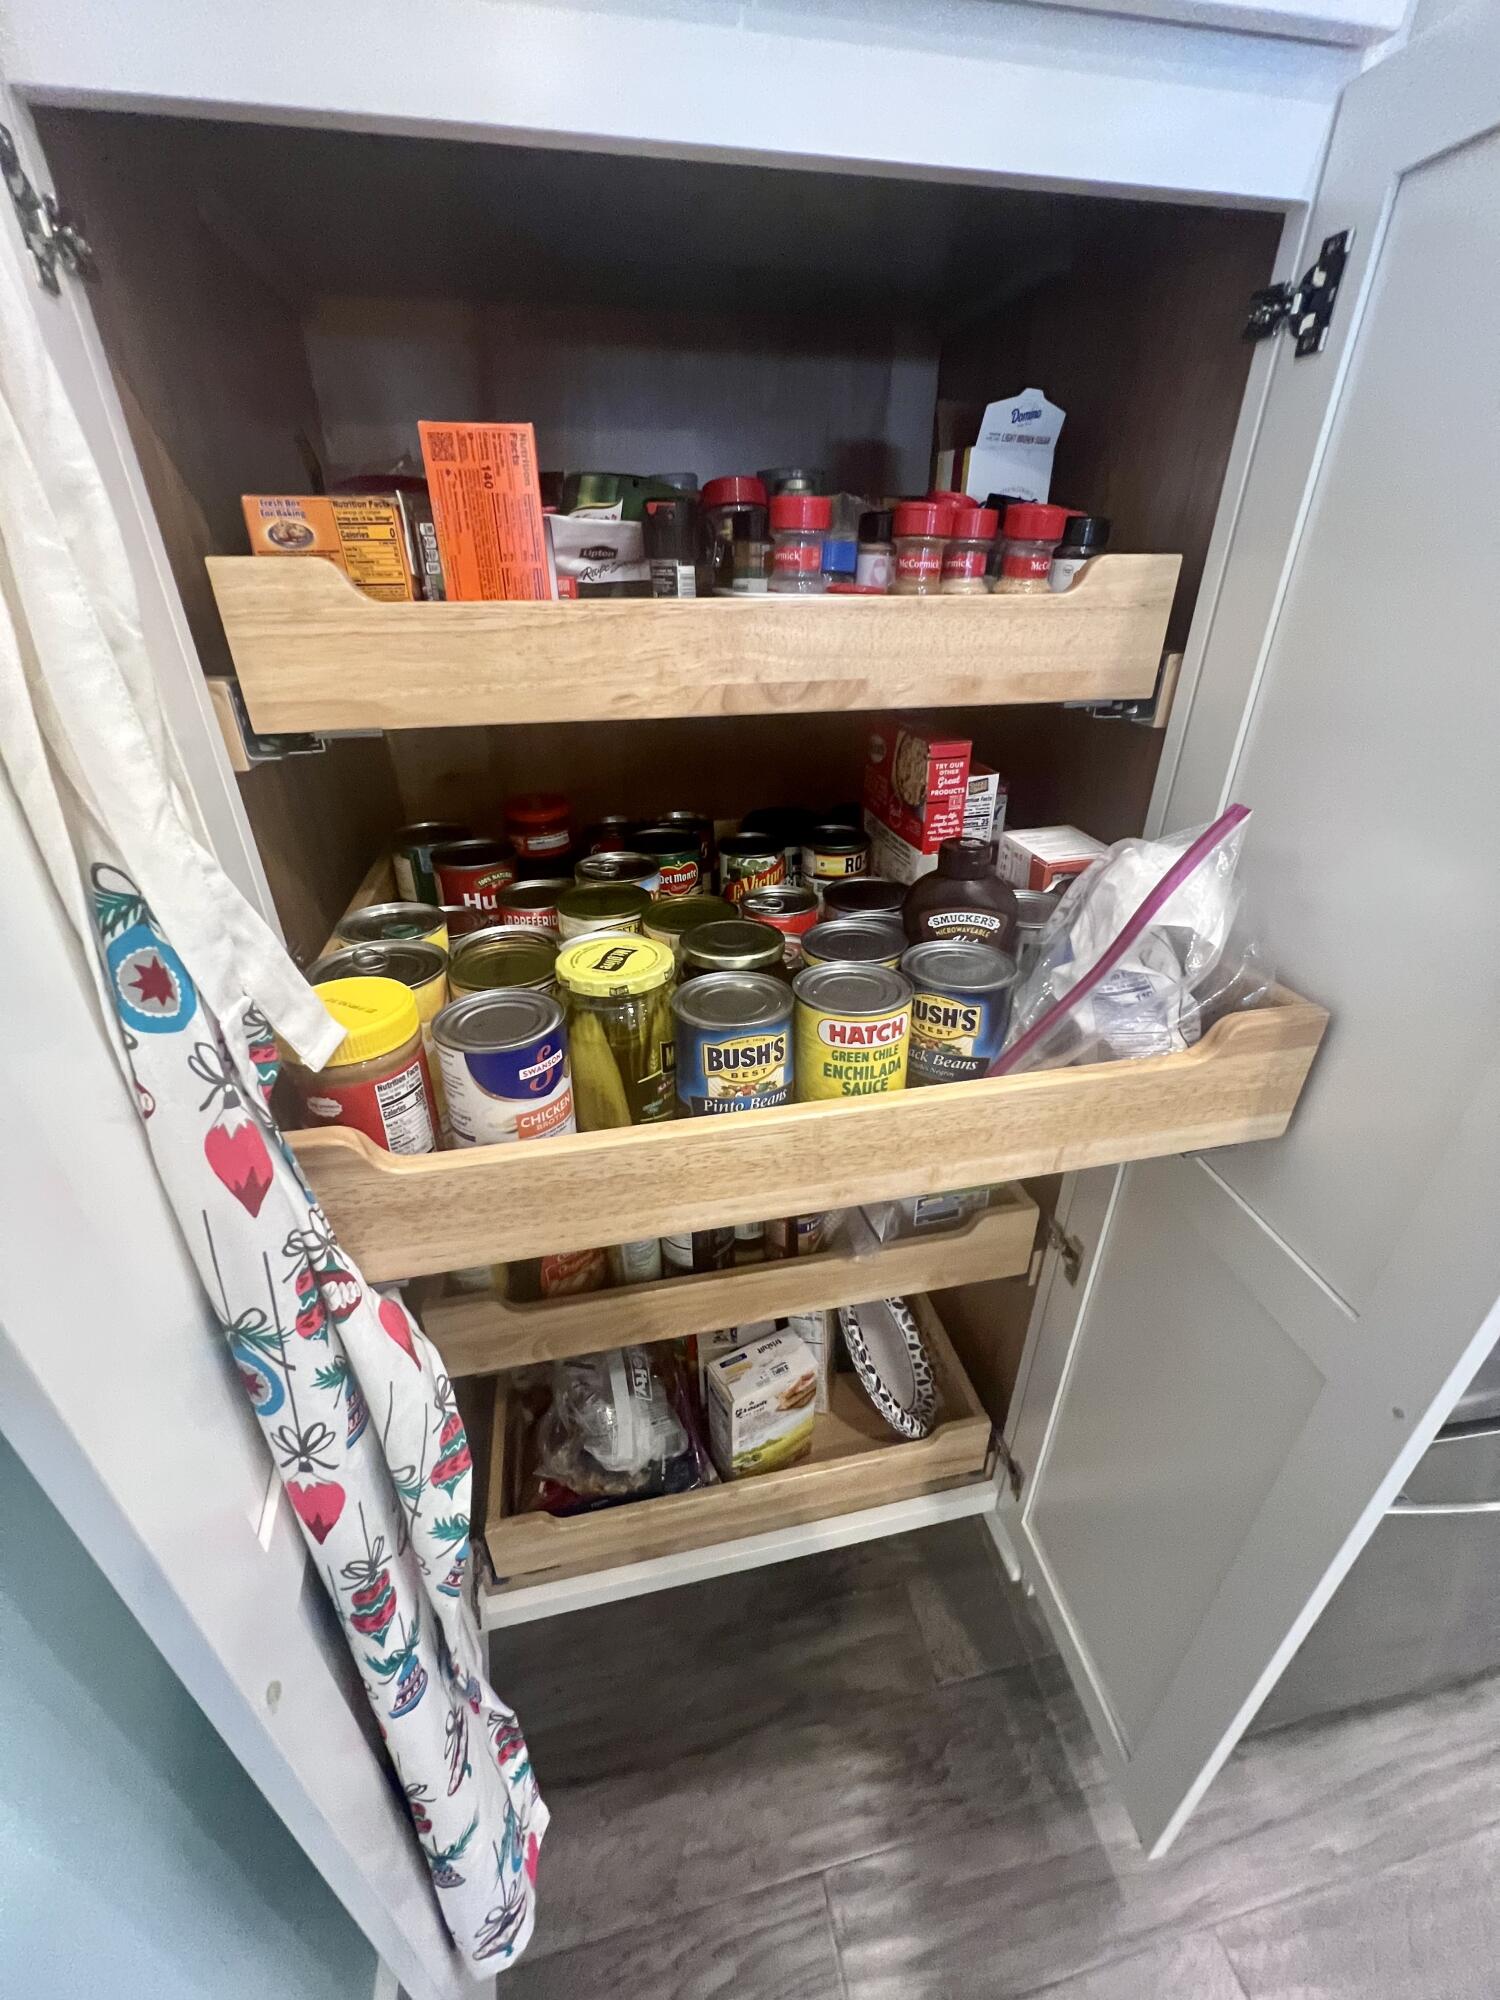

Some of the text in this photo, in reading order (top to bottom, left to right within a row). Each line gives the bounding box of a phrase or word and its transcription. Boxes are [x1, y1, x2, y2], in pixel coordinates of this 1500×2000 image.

[1011, 408, 1042, 423] Domino
[509, 432, 519, 466] Facts
[519, 433, 531, 486] Nutrition
[480, 466, 493, 489] 140
[332, 500, 392, 509] Nutrition Facts
[341, 528, 396, 539] Calories 0
[583, 549, 615, 558] Lipton
[949, 761, 964, 769] OUR
[930, 786, 965, 796] PRODUCTS
[660, 870, 697, 884] Del Monte
[463, 893, 498, 910] Hu
[932, 914, 996, 927] SMUCKER'S
[935, 927, 991, 938] MICROWAVEABLE
[829, 1017, 904, 1045] HATCH
[918, 1023, 953, 1036] BEST
[707, 1037, 785, 1071] BUSH'S
[831, 1044, 899, 1062] GREEN CHILE
[522, 1053, 561, 1078] SWANSON
[823, 1056, 902, 1081] ENCHILADA
[933, 1054, 979, 1070] Beans
[730, 1067, 767, 1079] BEST
[377, 1074, 406, 1092] Nutrition
[841, 1076, 889, 1096] SAUCE
[704, 1088, 788, 1113] Pinto Beans
[382, 1104, 406, 1118] Calories
[520, 1092, 570, 1128] CHICKEN
[536, 1112, 565, 1131] BROTH
[756, 1337, 782, 1354] triscuit
[631, 1350, 652, 1399] efty
